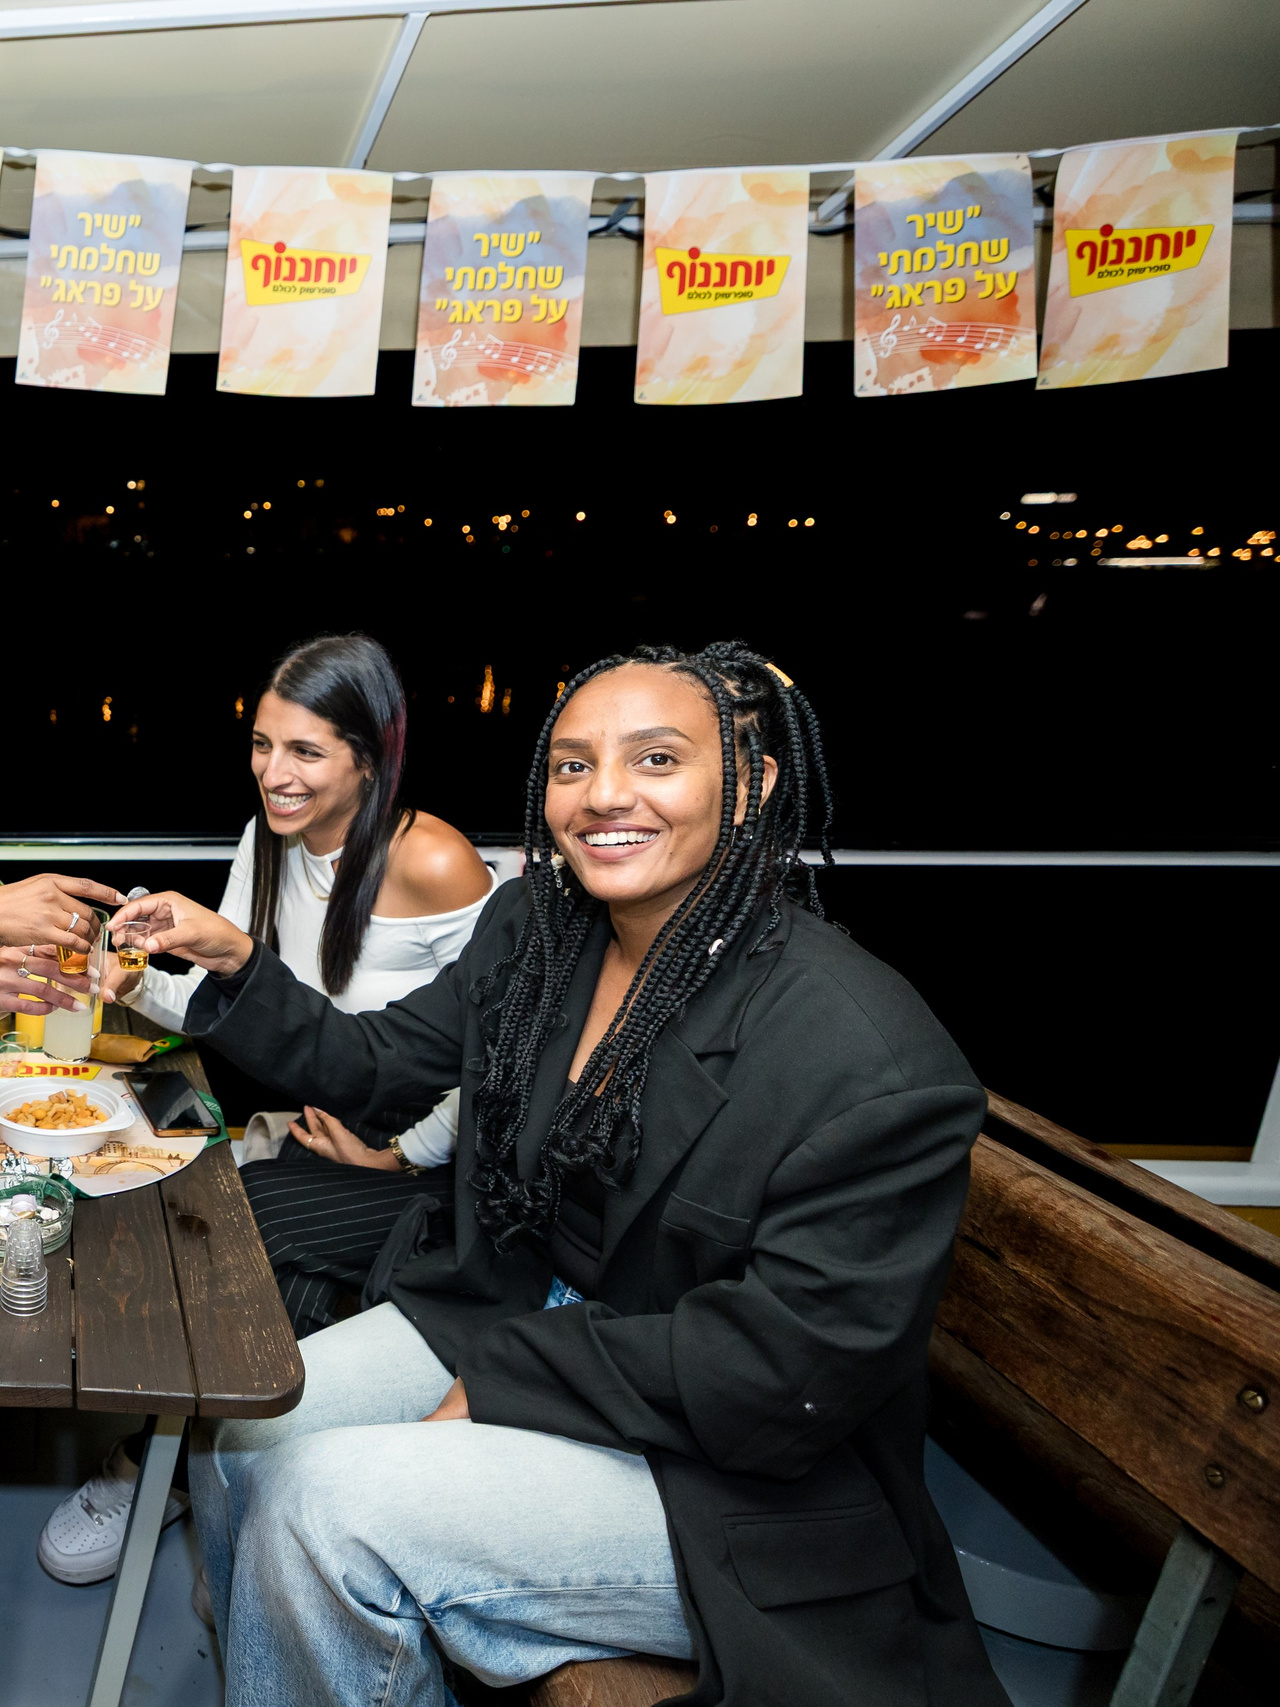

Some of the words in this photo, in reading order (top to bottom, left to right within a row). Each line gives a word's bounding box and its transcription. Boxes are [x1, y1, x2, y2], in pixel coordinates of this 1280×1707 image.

[49, 243, 160, 276] שחלמתי
[878, 237, 1009, 276] שחלמתי
[444, 261, 564, 291] שחלמתי
[974, 269, 1018, 300] על
[129, 279, 164, 312] על
[530, 294, 569, 325] על
